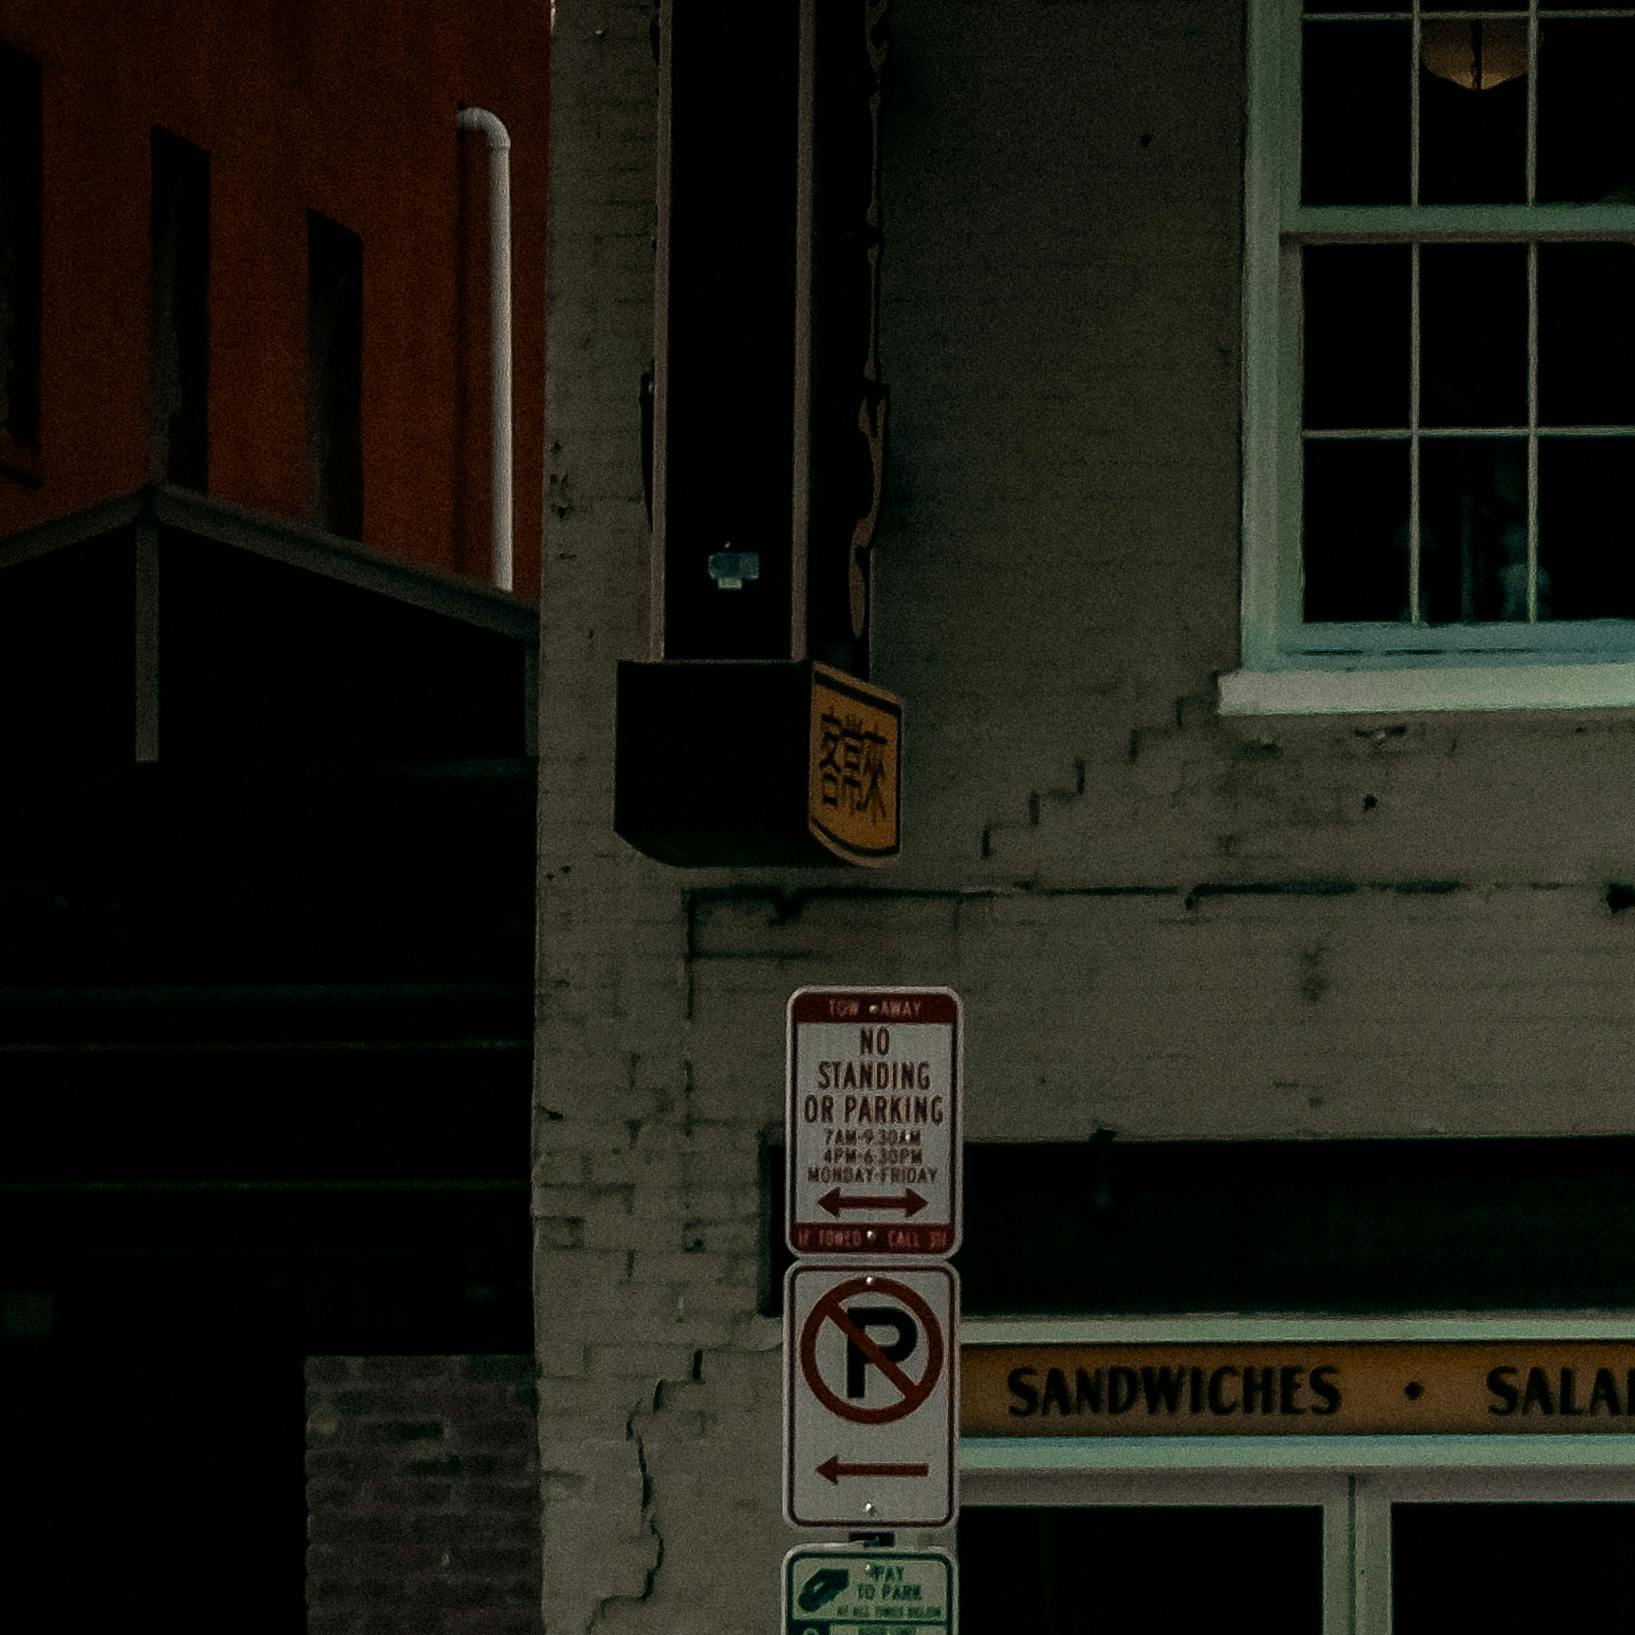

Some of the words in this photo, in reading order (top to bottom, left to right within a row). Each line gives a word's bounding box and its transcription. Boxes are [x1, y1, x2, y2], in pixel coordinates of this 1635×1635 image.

[881, 999, 921, 1017] AWAY
[860, 1027, 890, 1056] NO
[818, 1062, 931, 1090] STANDING
[804, 1095, 834, 1124] OR
[845, 1095, 944, 1124] PARKING
[1008, 1366, 1343, 1416] SANDWICHES
